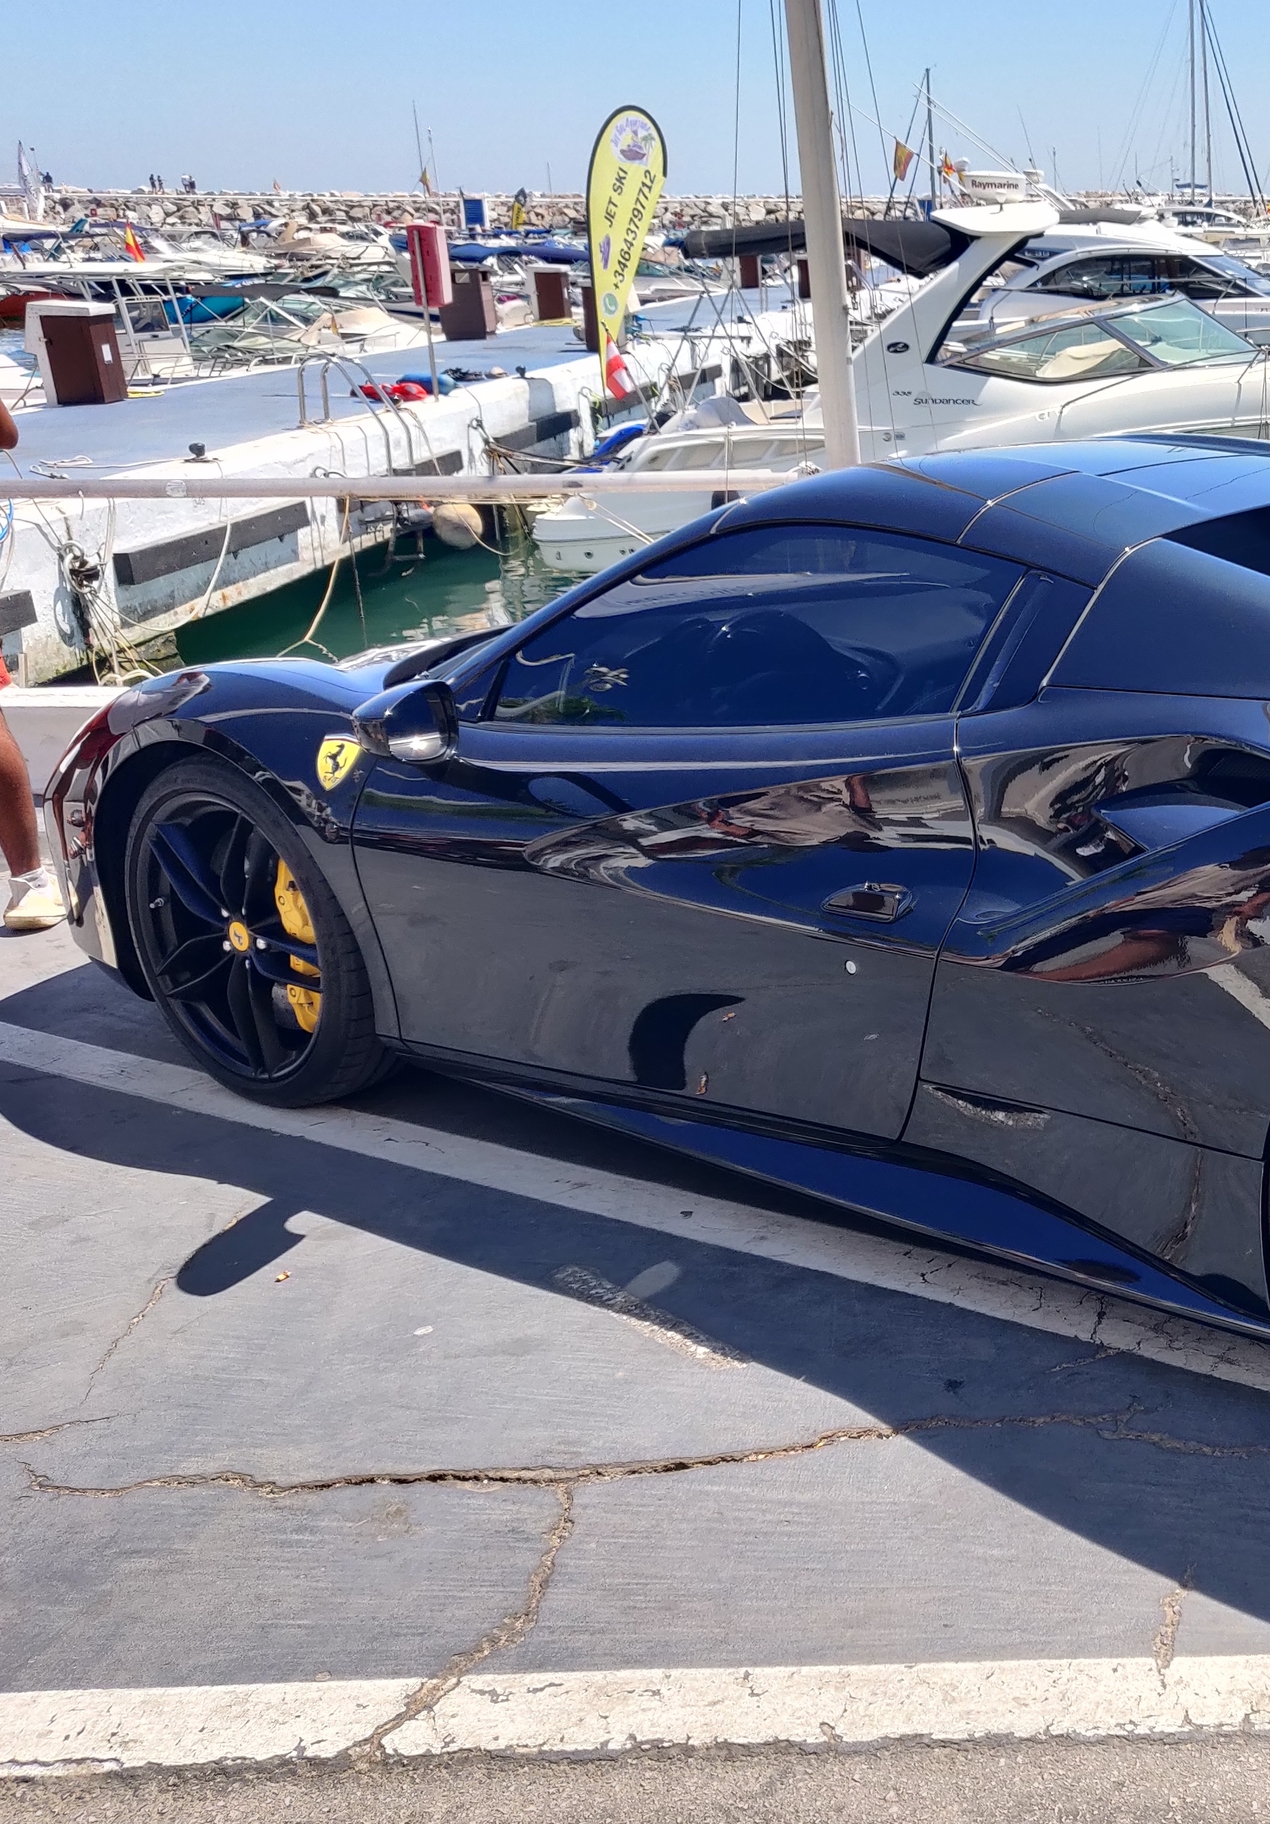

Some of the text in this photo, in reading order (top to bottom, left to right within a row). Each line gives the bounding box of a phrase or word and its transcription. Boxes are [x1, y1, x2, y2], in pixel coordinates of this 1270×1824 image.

[604, 166, 628, 228] JET SKI
[971, 179, 1019, 190] Raymarine
[613, 169, 656, 290] +34643797712
